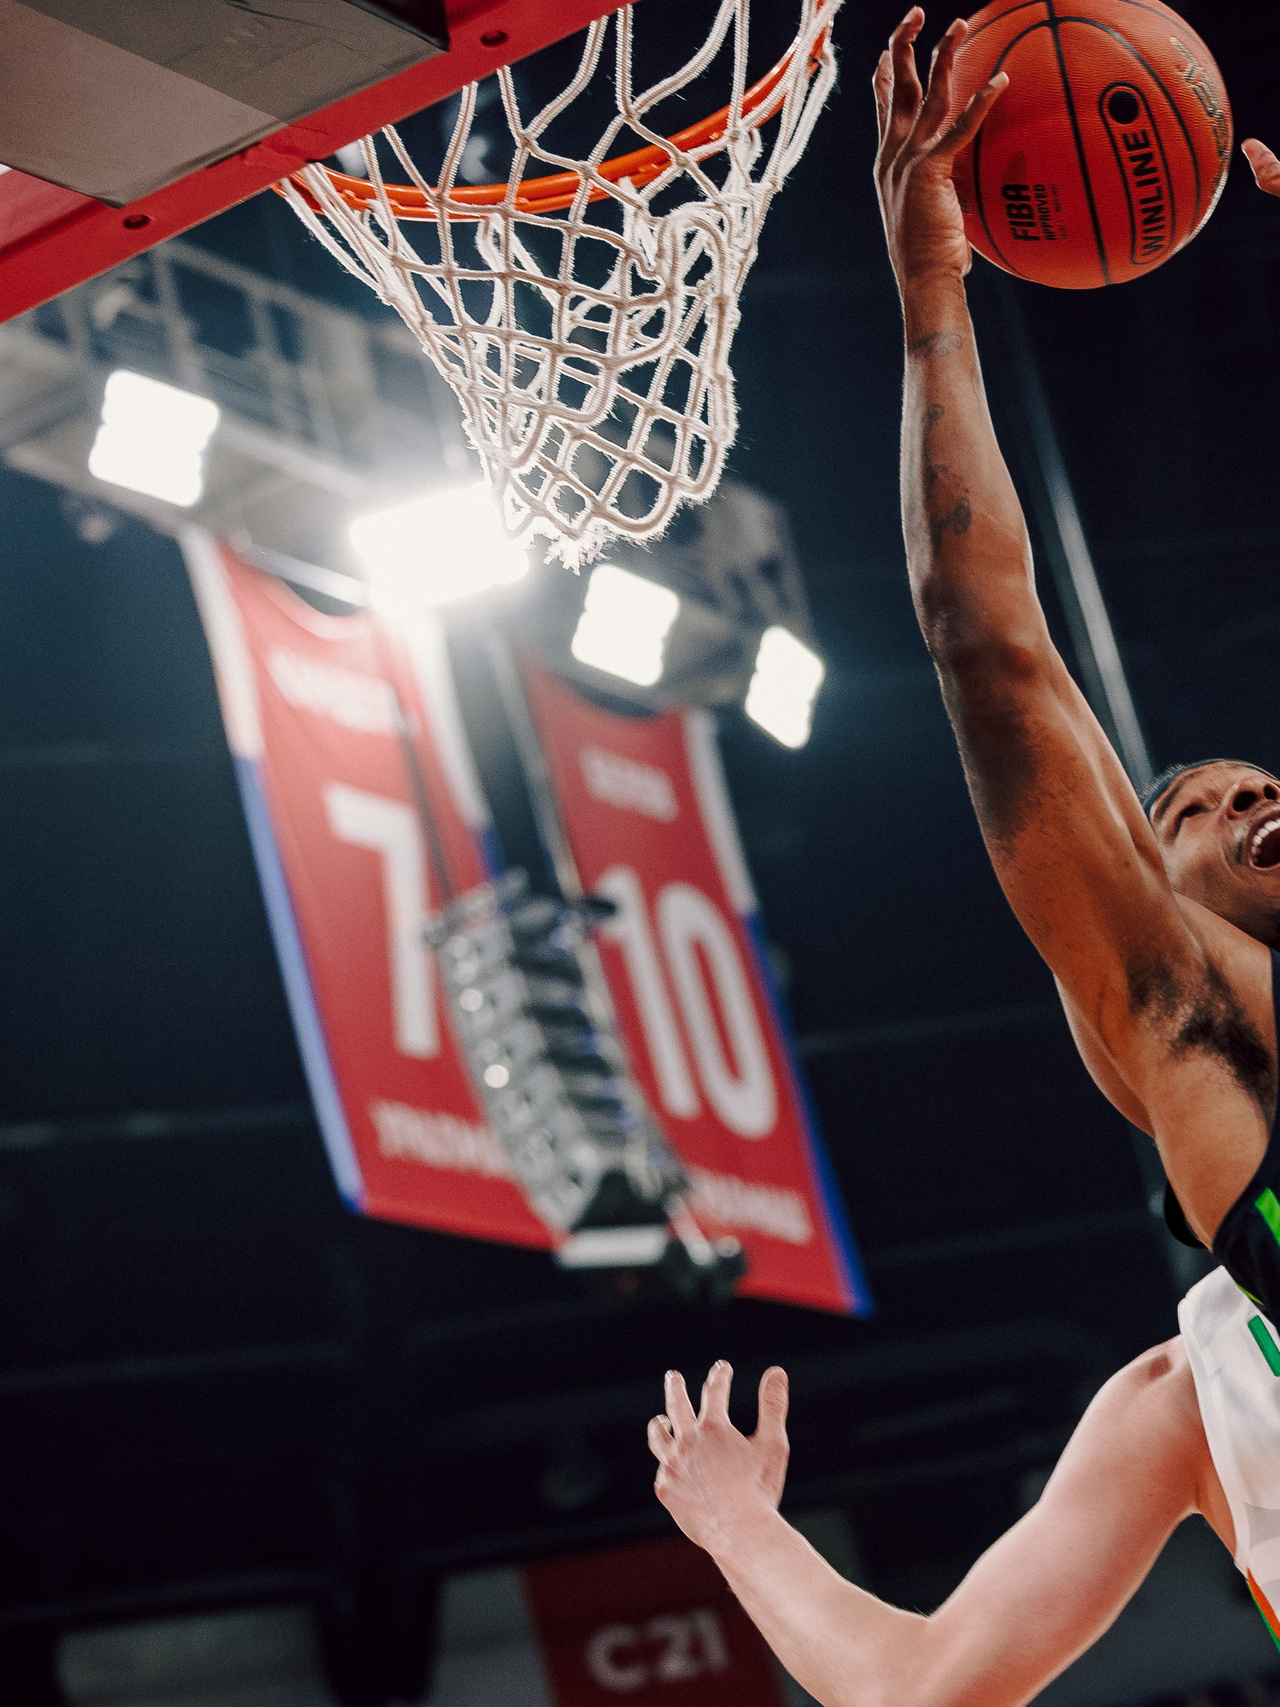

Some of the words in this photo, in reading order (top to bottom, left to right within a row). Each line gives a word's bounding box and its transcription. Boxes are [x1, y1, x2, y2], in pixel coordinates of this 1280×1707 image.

[1002, 184, 1041, 242] FIBA
[1121, 129, 1166, 257] WINLINE
[322, 782, 440, 1060] 7
[590, 863, 779, 1140] 10
